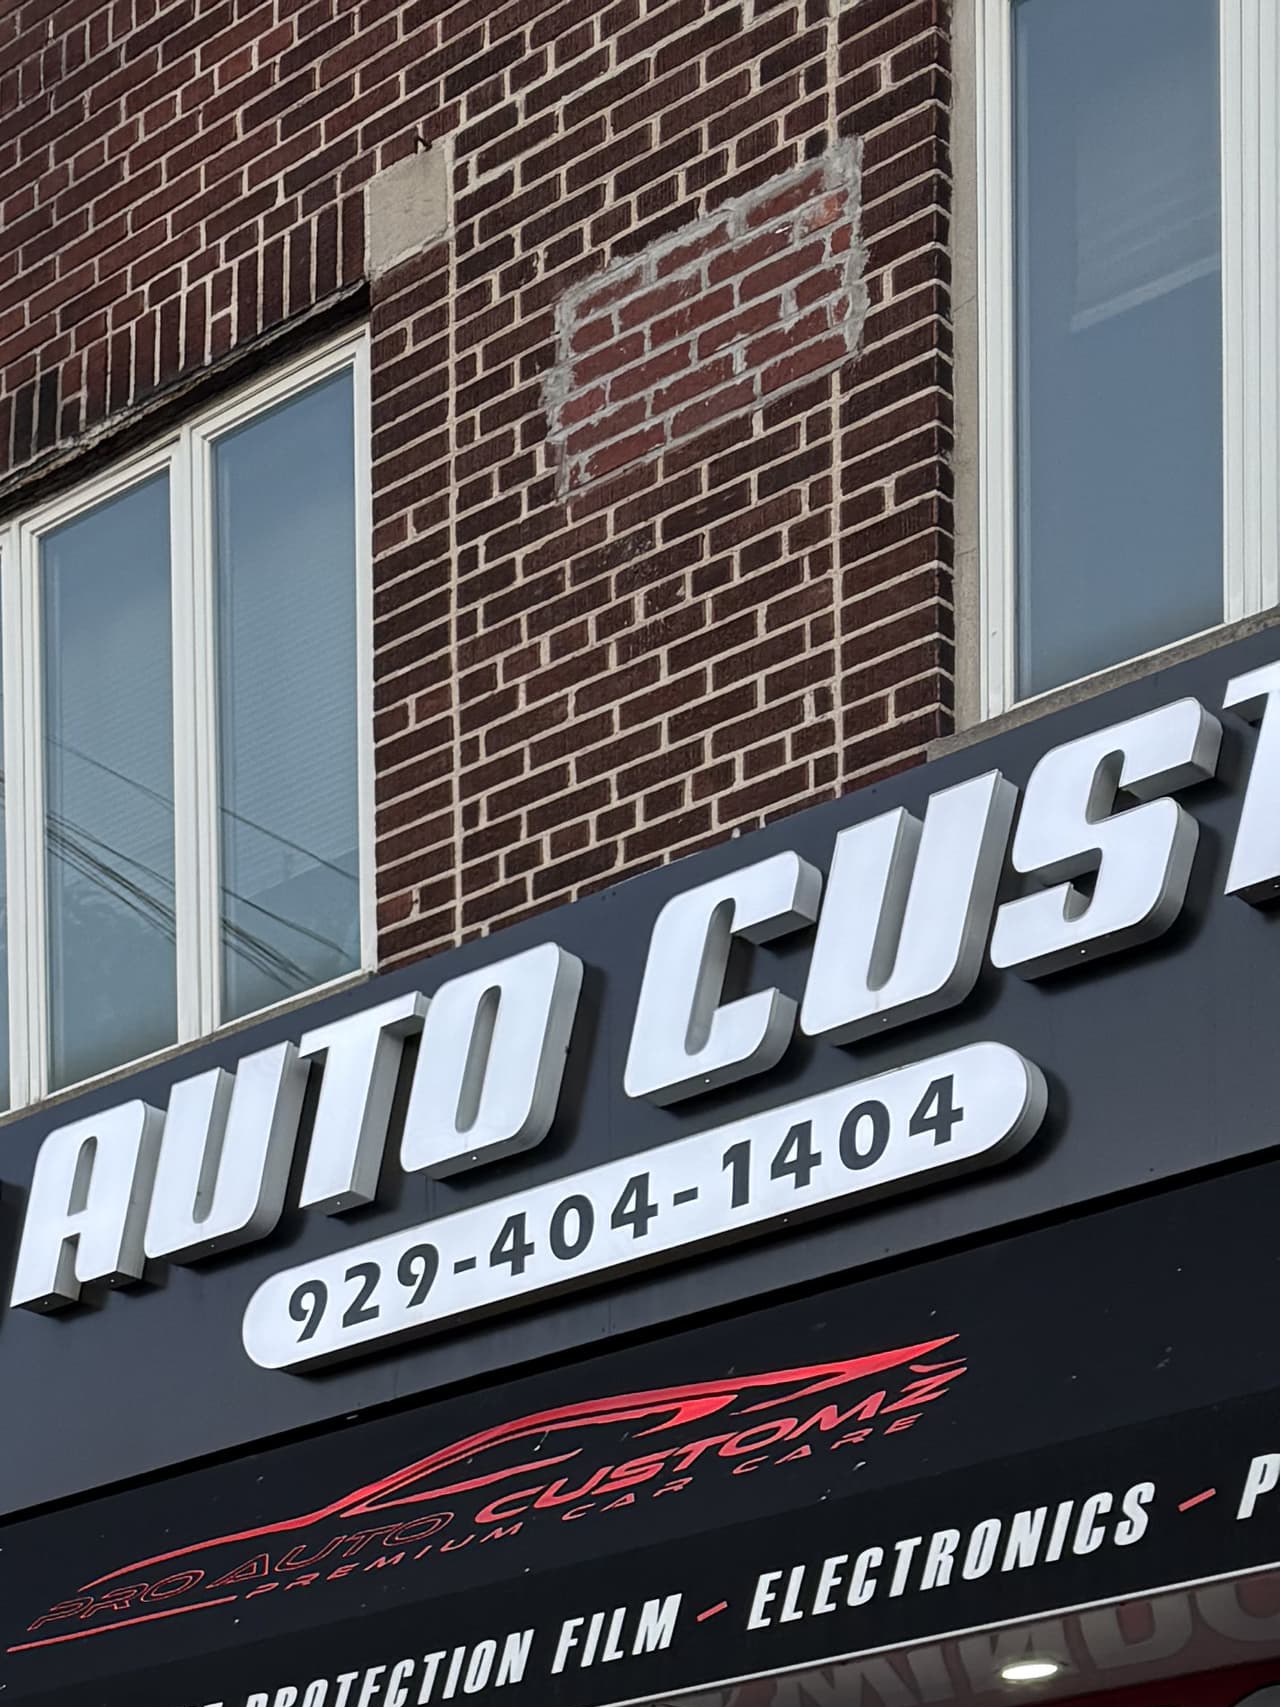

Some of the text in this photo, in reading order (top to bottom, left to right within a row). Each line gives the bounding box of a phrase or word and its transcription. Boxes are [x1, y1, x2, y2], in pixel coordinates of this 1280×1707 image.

[11, 941, 572, 1310] AUTO
[287, 1074, 967, 1344] 929-404-1404
[27, 1366, 968, 1631] PRO AUTO CUSTOMZ
[245, 1413, 924, 1599] PREMIUM CAR CARE
[550, 1593, 683, 1674] FILM
[746, 1481, 1156, 1632] ELECTRONICS
